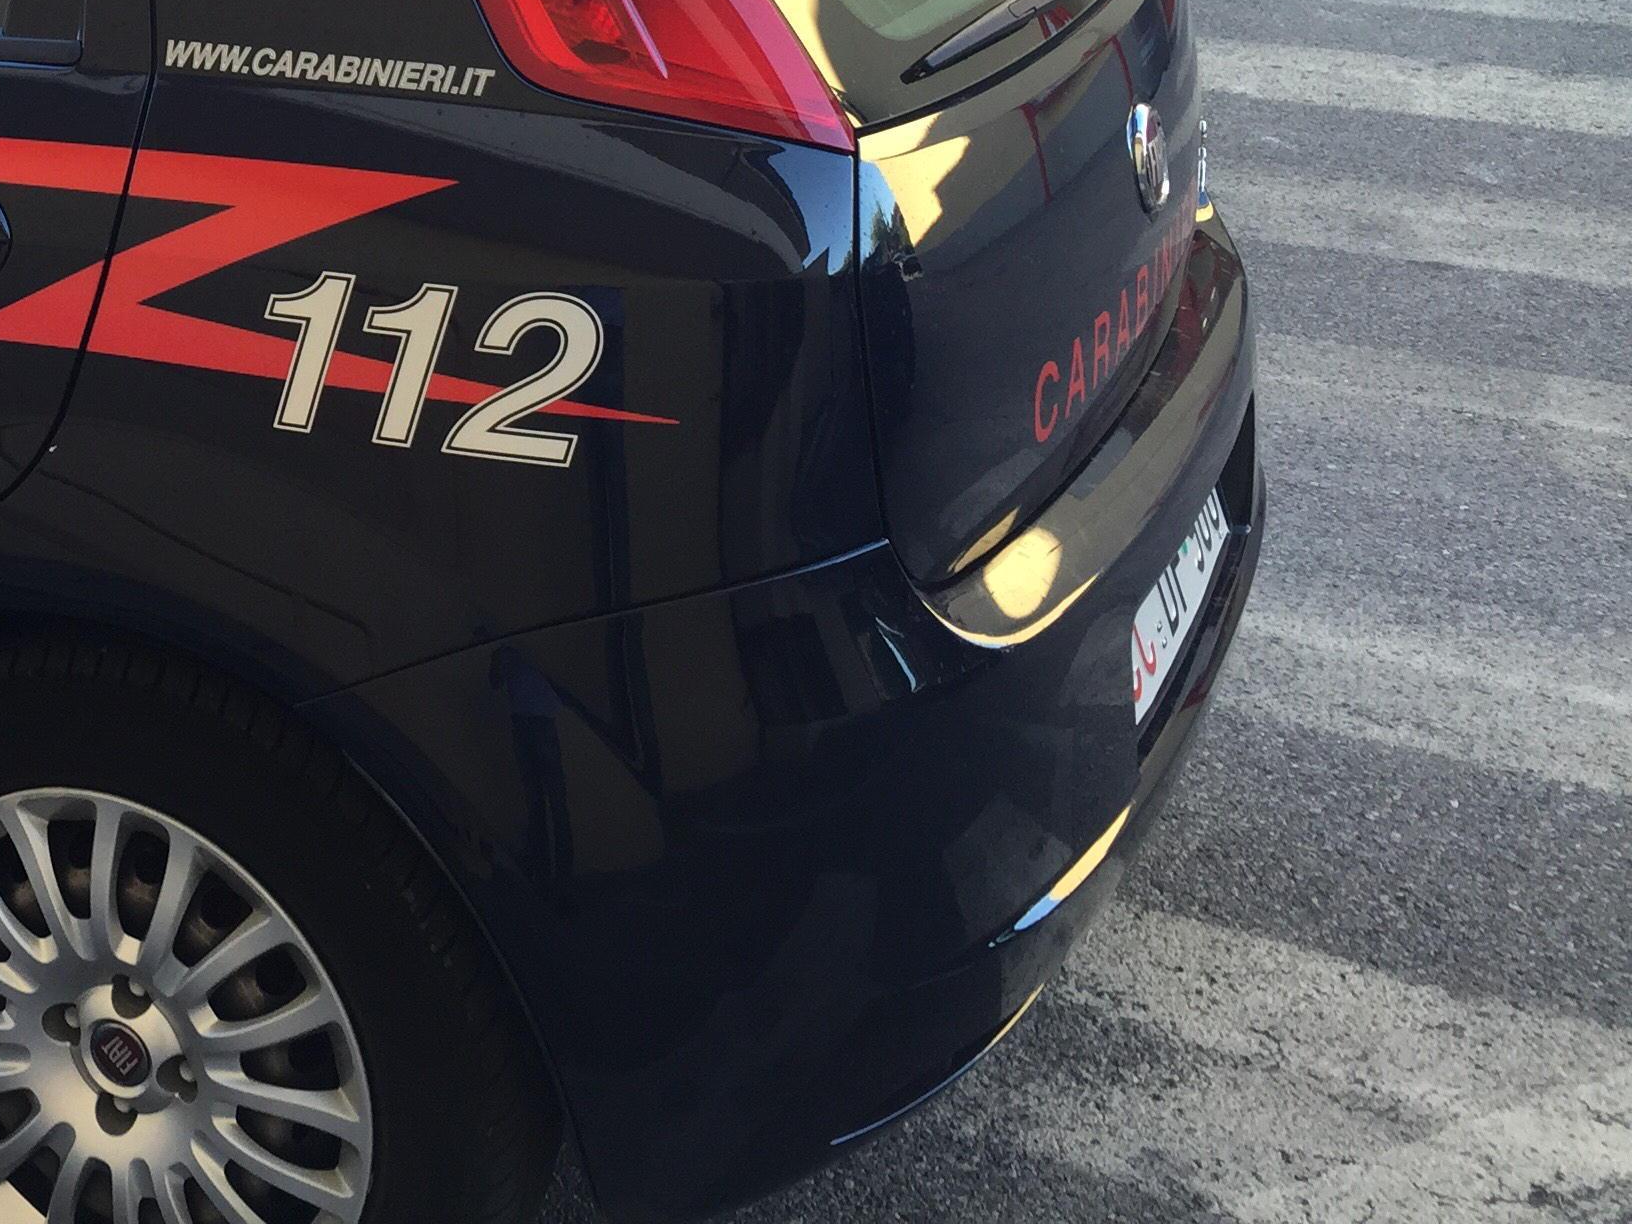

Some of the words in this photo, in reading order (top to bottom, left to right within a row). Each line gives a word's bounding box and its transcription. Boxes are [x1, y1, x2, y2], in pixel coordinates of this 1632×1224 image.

[165, 39, 496, 97] WWW.CARABINIERI.IT
[264, 270, 604, 468] 112
[101, 1036, 139, 1076] FIAT
